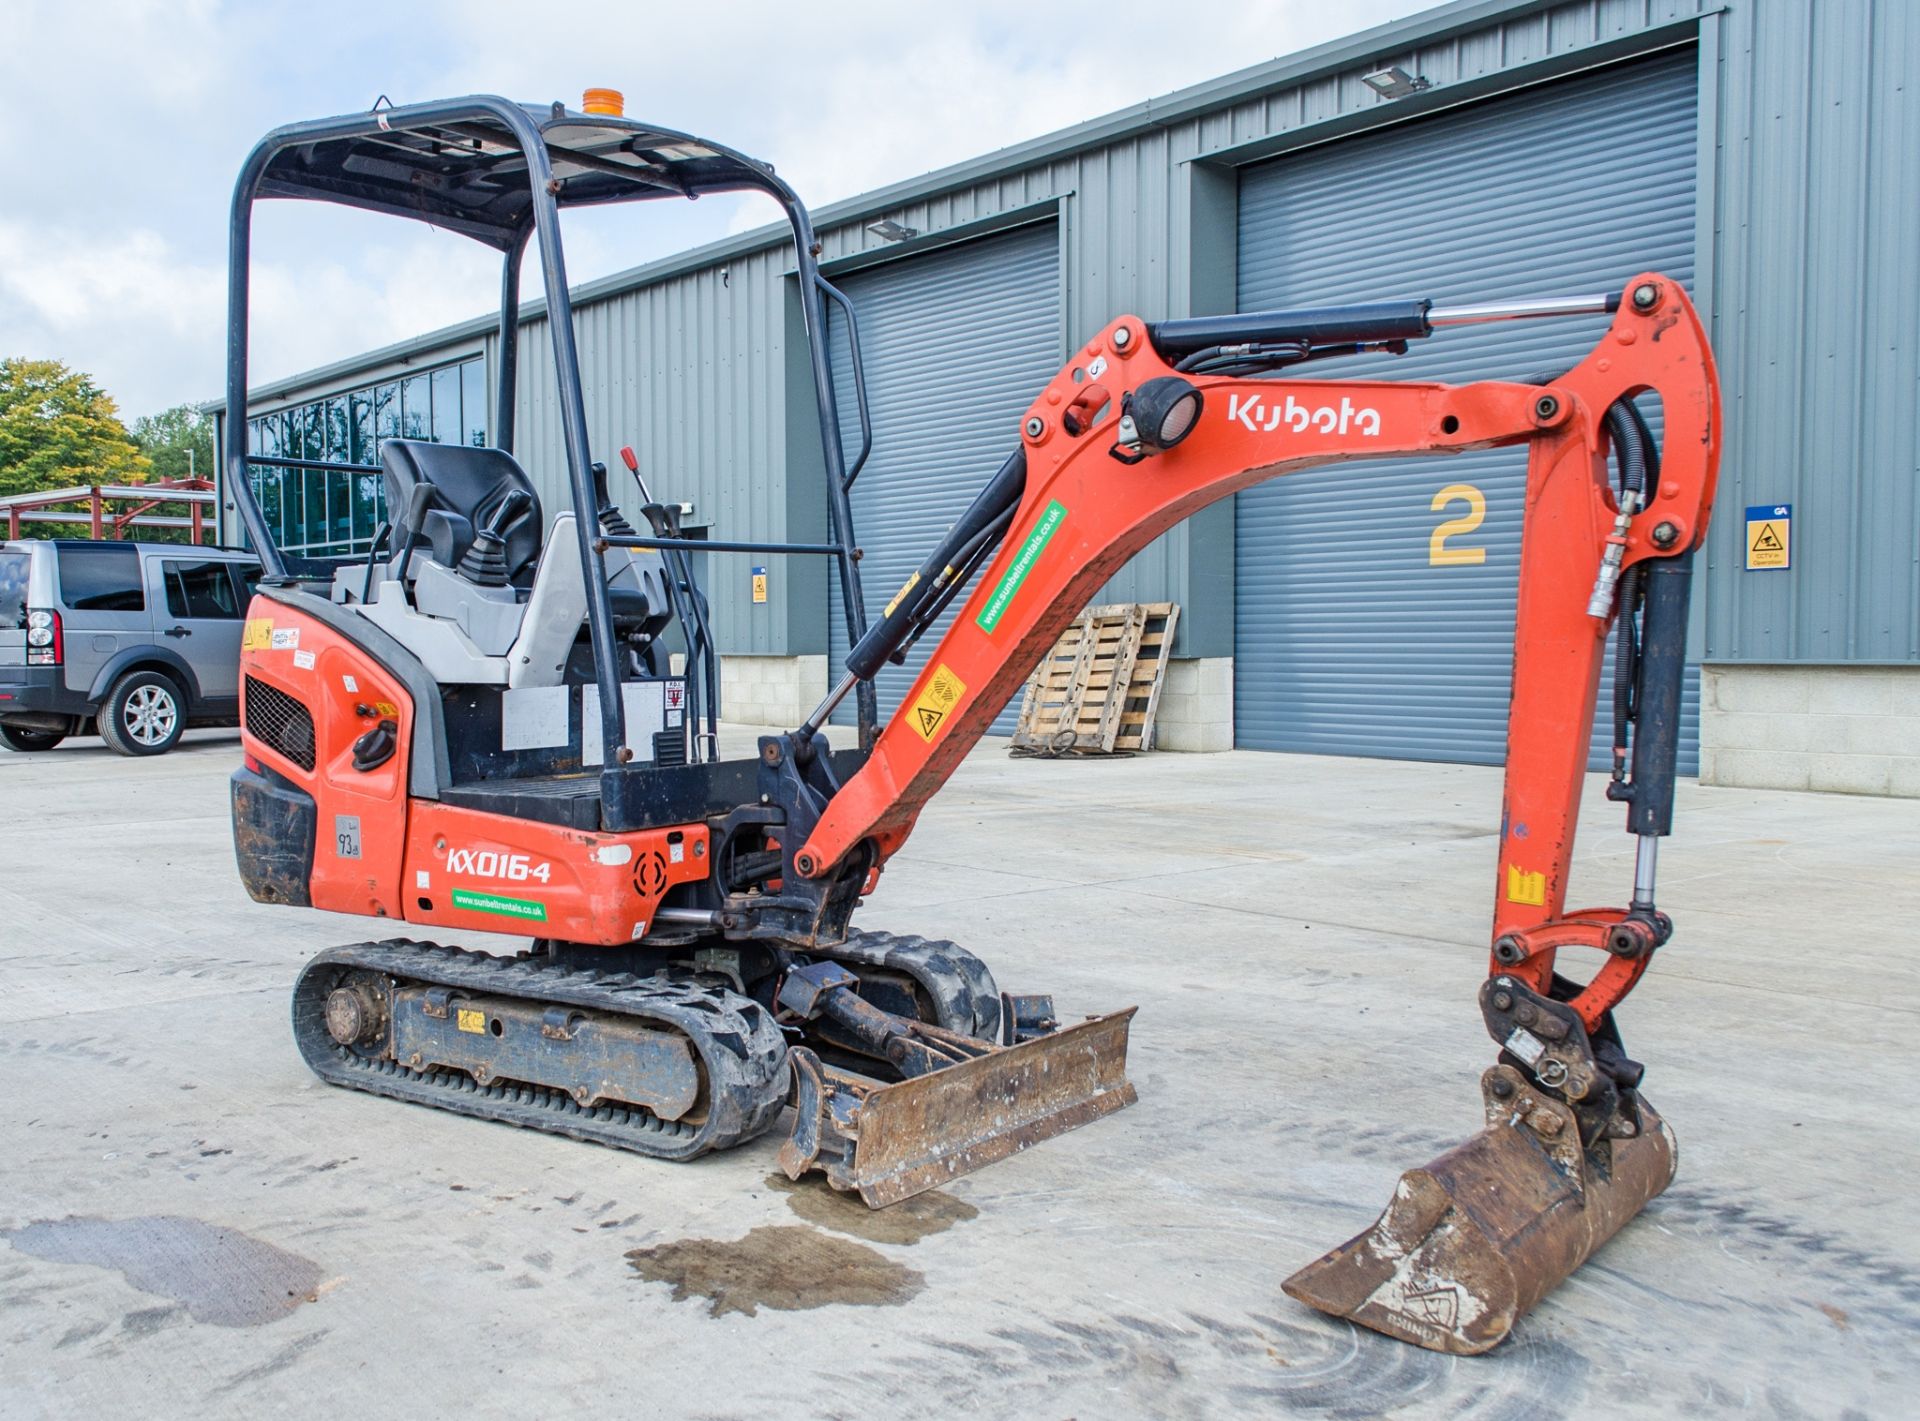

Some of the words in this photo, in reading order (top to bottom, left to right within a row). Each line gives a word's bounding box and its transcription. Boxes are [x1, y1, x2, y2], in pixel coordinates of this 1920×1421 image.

[1227, 393, 1382, 436] Kubota
[1428, 484, 1487, 566] 2
[983, 507, 1061, 625] www.sunbeltrentals.co.uk
[338, 833, 352, 855] 93
[455, 895, 544, 916] www.sunbeltrentals.co.uk
